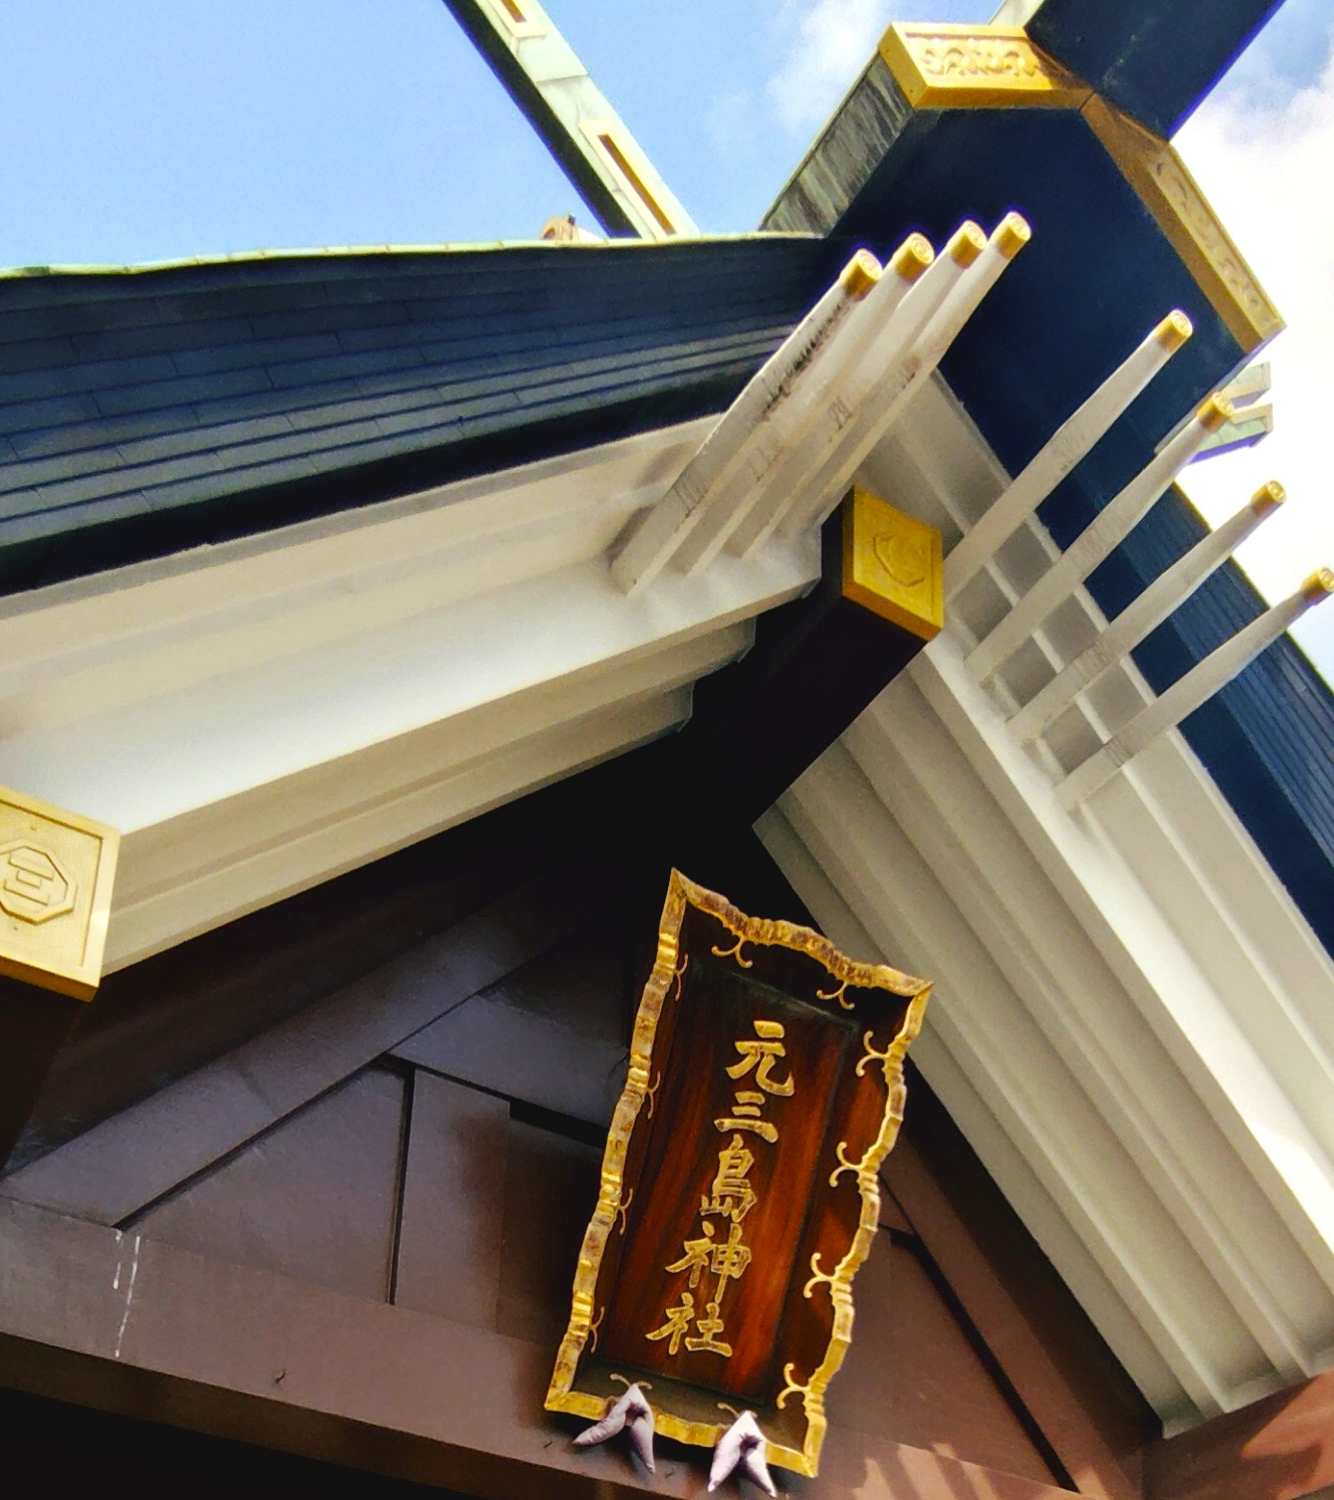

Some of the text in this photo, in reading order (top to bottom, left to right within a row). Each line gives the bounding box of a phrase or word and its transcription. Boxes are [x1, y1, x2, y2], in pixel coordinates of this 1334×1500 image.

[645, 1020, 797, 1358] 元三島神社
